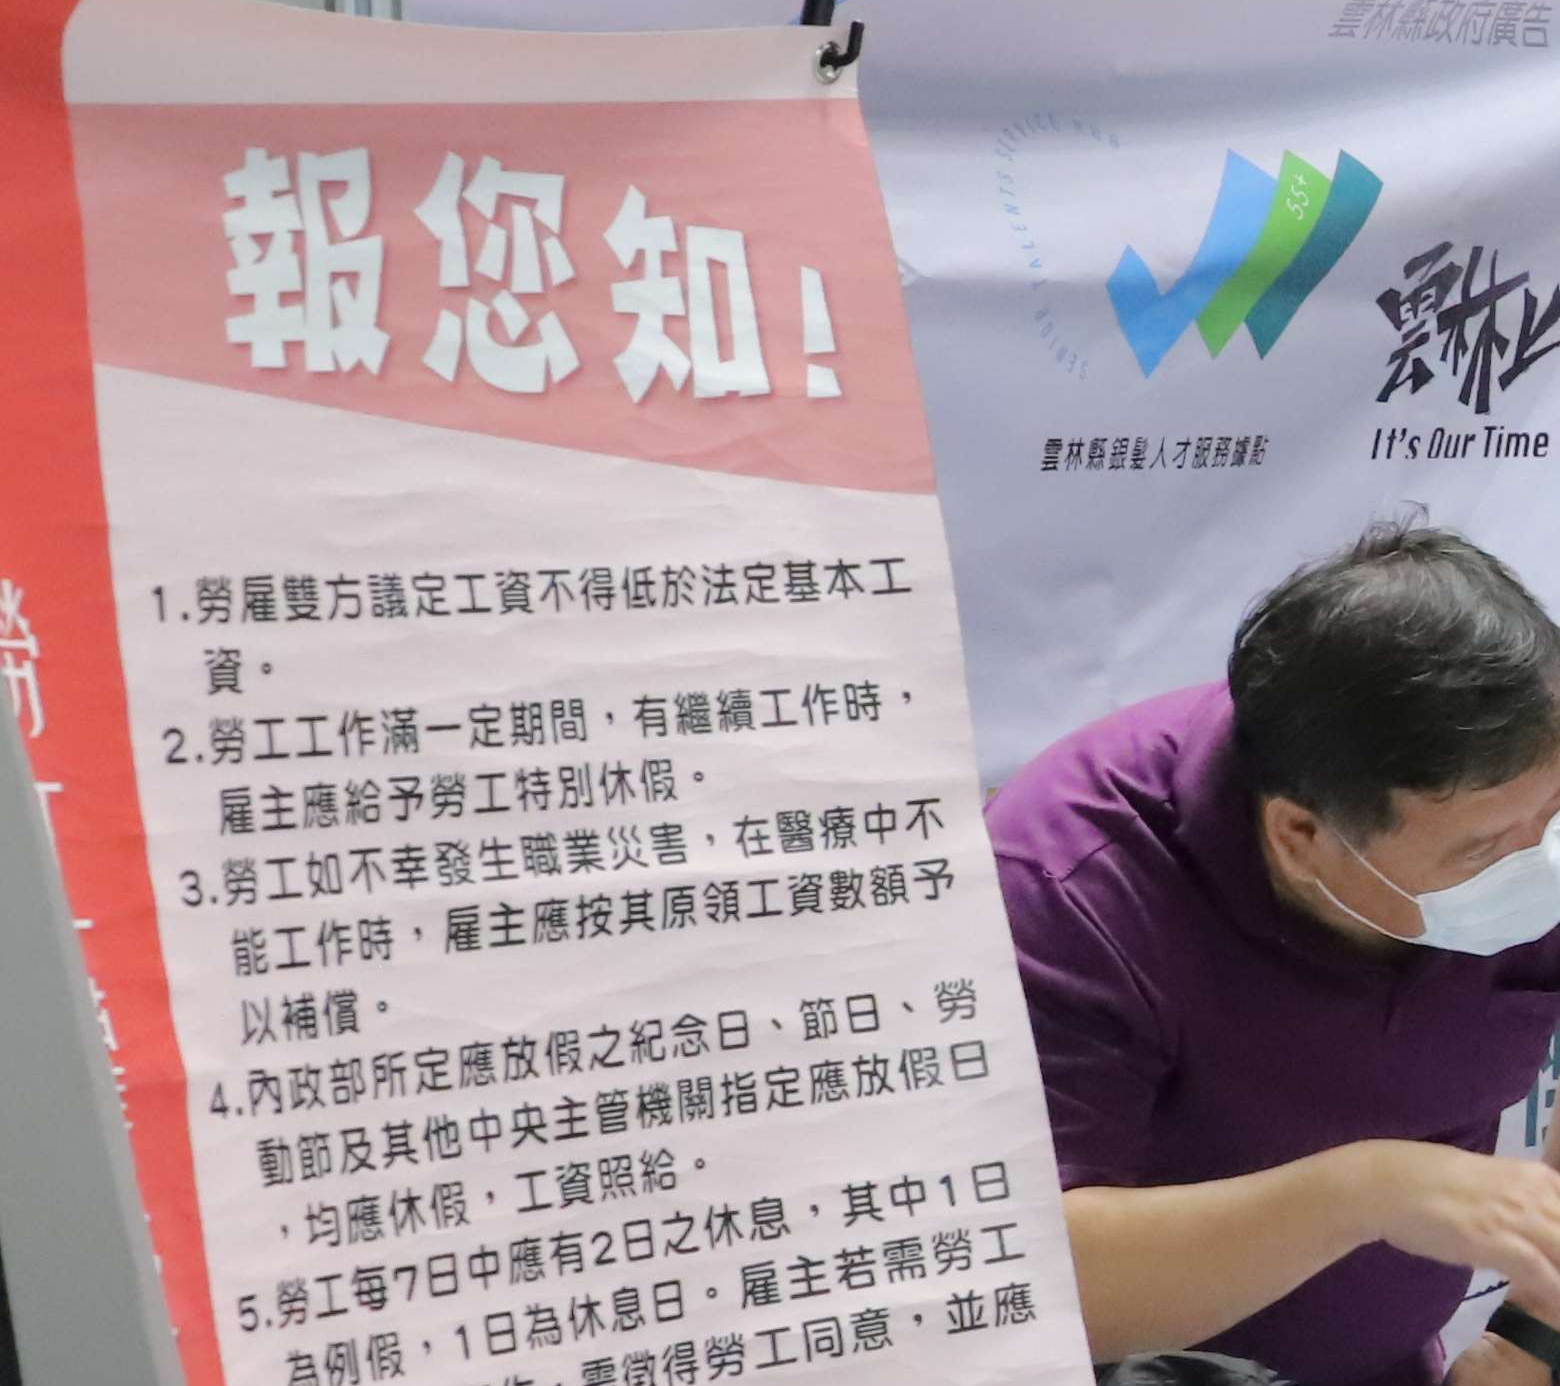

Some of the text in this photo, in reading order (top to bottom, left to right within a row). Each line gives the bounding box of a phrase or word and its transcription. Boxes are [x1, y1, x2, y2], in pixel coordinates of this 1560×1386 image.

[1040, 431, 1270, 473] 雲林縣銀髮人才服務據點
[1371, 427, 1549, 459] It's Our Time
[153, 555, 912, 627] 1.勞雇雙方議定工資不得低於法定基本工
[204, 645, 276, 699] 資。
[217, 757, 707, 838] 雇主應給予勞工特別休假。
[180, 795, 946, 909] 3.勞工如不幸發生職業災害，在醫療中不
[231, 857, 955, 977] 能工作時，雇主應按其原領工資數額予
[240, 985, 392, 1046] 以補償。
[255, 1039, 988, 1190] 動節及其他中央主管機關指定應放假日
